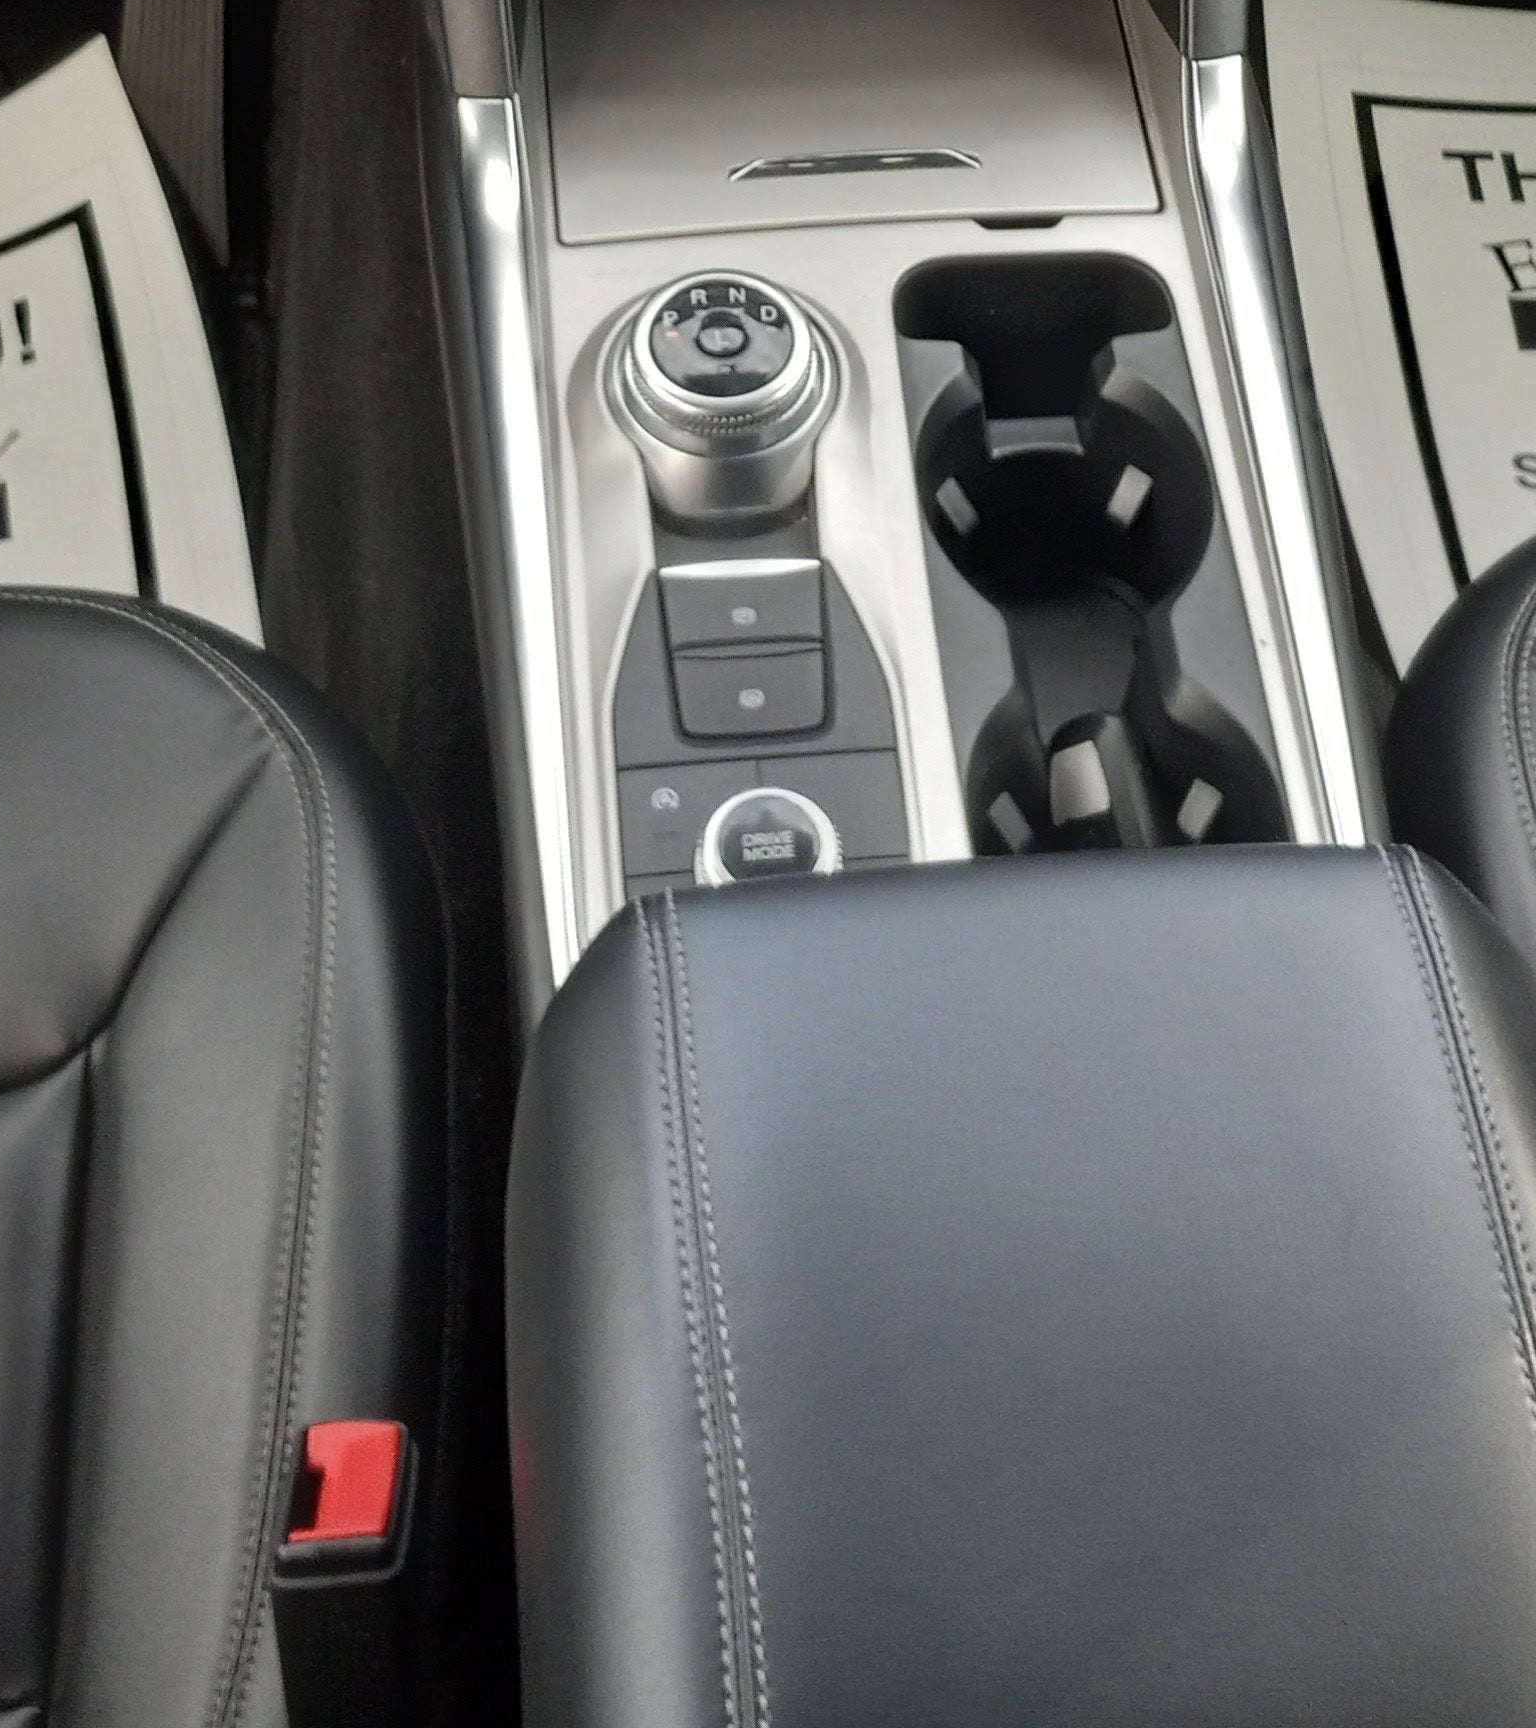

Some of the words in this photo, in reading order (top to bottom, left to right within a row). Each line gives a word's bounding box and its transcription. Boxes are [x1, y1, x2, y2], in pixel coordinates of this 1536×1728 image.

[661, 310, 679, 327] P
[690, 288, 708, 305] R
[729, 287, 746, 304] N
[760, 305, 778, 323] D
[741, 831, 794, 846] DRIVE
[742, 846, 796, 861] MODE
